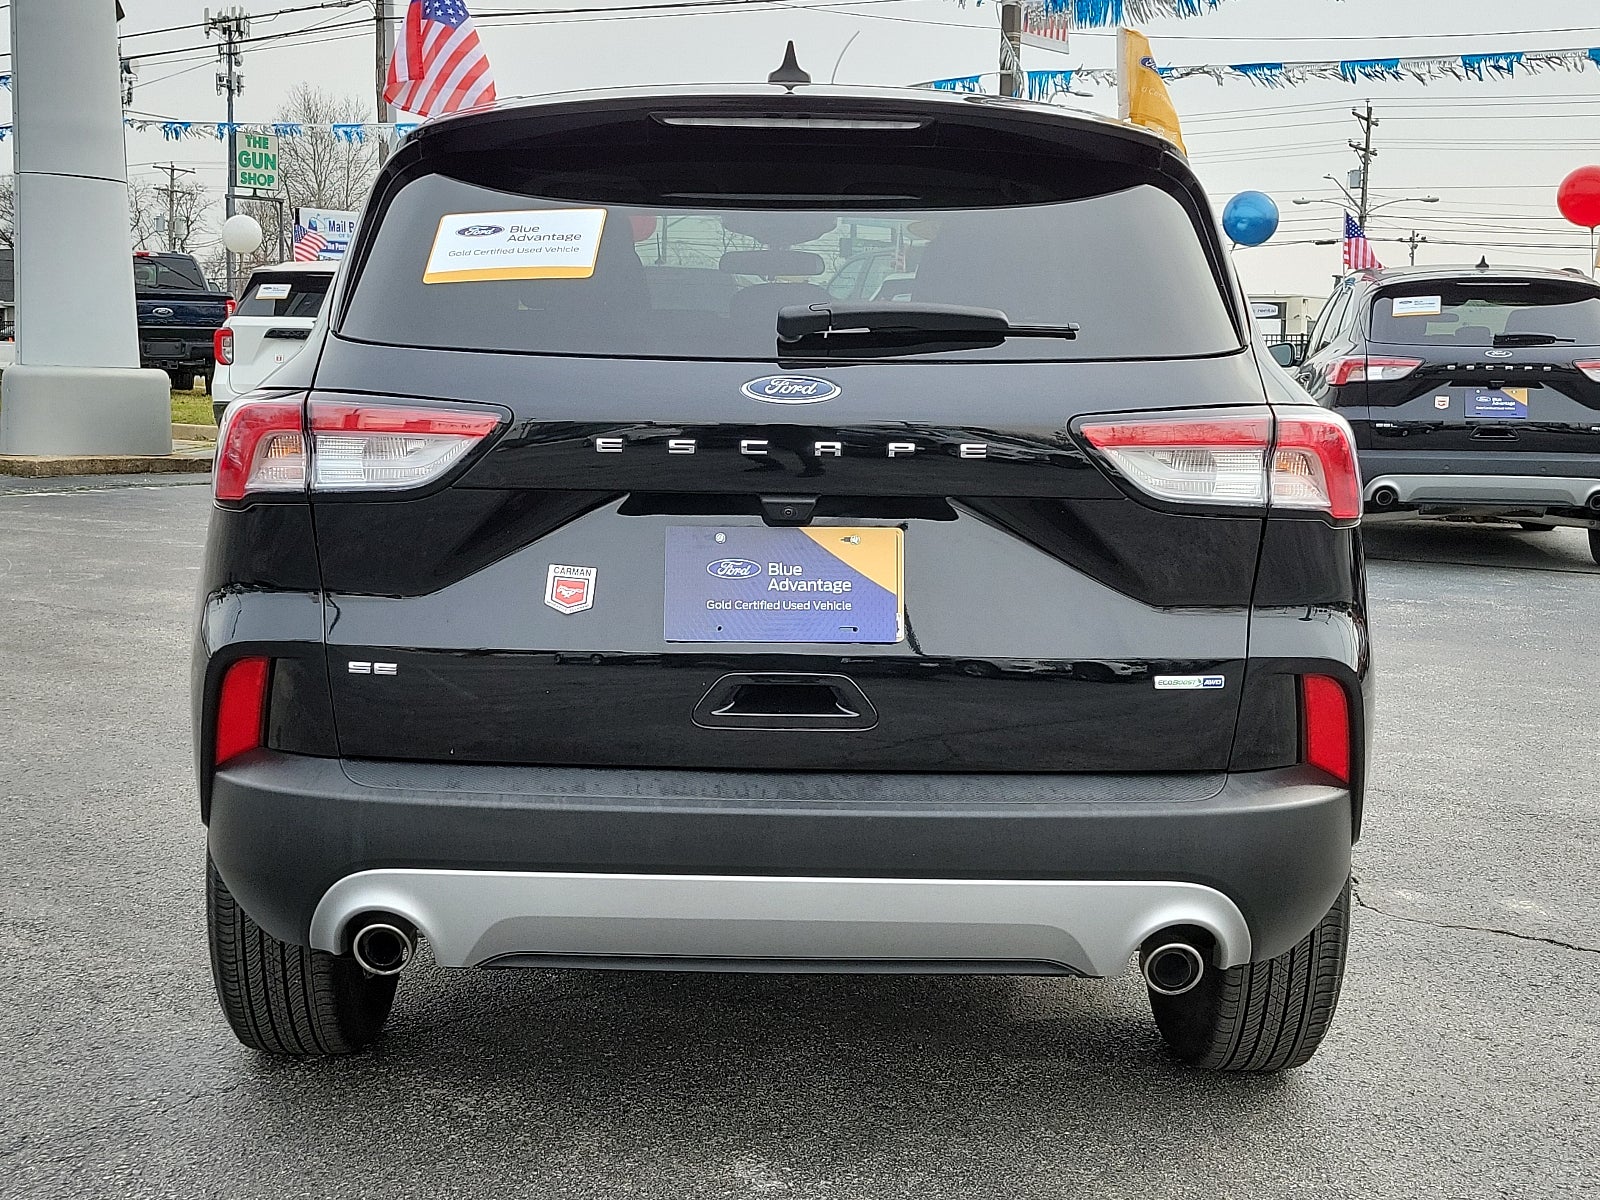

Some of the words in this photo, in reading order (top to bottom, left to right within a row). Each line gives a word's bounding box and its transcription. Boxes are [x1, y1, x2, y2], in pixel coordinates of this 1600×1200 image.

[245, 135, 269, 149] THE
[238, 151, 277, 170] GUN
[240, 172, 275, 186] SHOP
[328, 220, 346, 233] Mail
[510, 225, 540, 233] Blue
[507, 233, 582, 242] Advantage
[473, 247, 515, 256] Certified
[517, 246, 542, 254] Used
[595, 437, 988, 459] ESCAPE
[553, 566, 592, 577] CARMAN
[768, 562, 803, 576] Blue
[767, 577, 852, 594] Advantage
[706, 600, 732, 610] Gold
[734, 600, 781, 610] Certified
[782, 600, 811, 610] Used
[813, 600, 852, 611] Vehicle
[348, 661, 398, 676] SE
